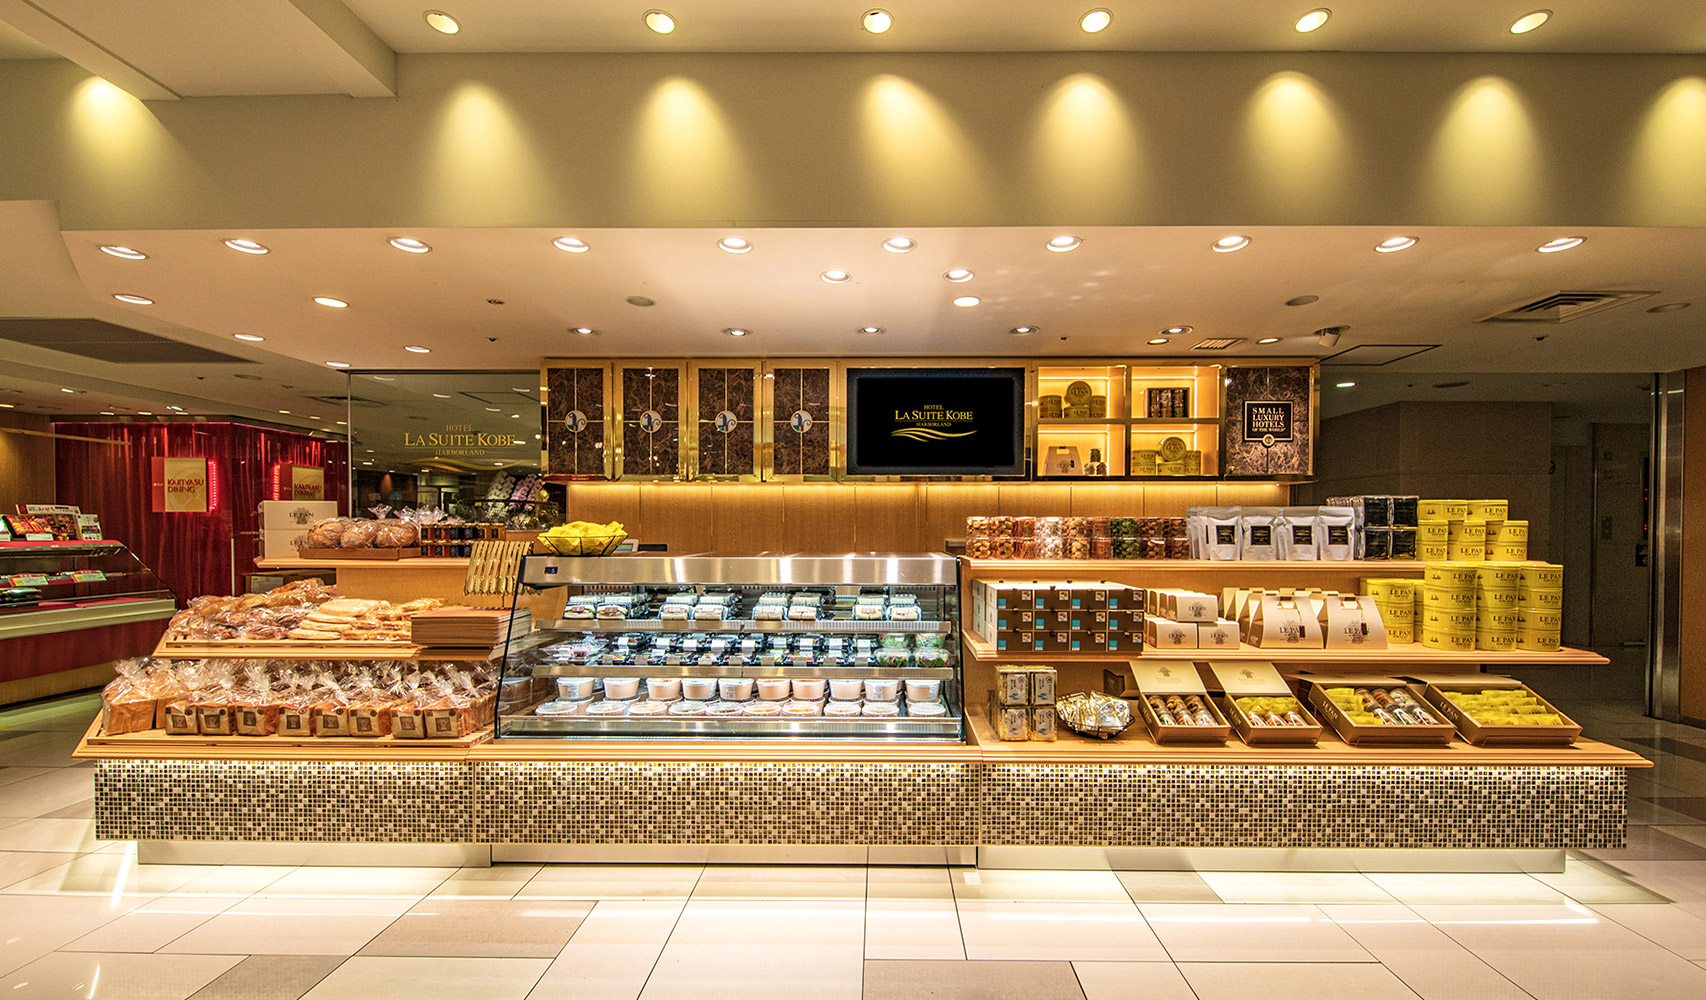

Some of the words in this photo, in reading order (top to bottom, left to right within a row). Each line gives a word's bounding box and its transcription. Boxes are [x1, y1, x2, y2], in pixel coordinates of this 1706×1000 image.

[895, 410, 910, 420] LA
[912, 410, 944, 420] SUITE
[946, 410, 973, 420] KOBE
[405, 433, 425, 446] LA
[428, 432, 474, 446] SUITE
[478, 433, 516, 446] KOBE
[167, 478, 204, 486] KAKIYASU
